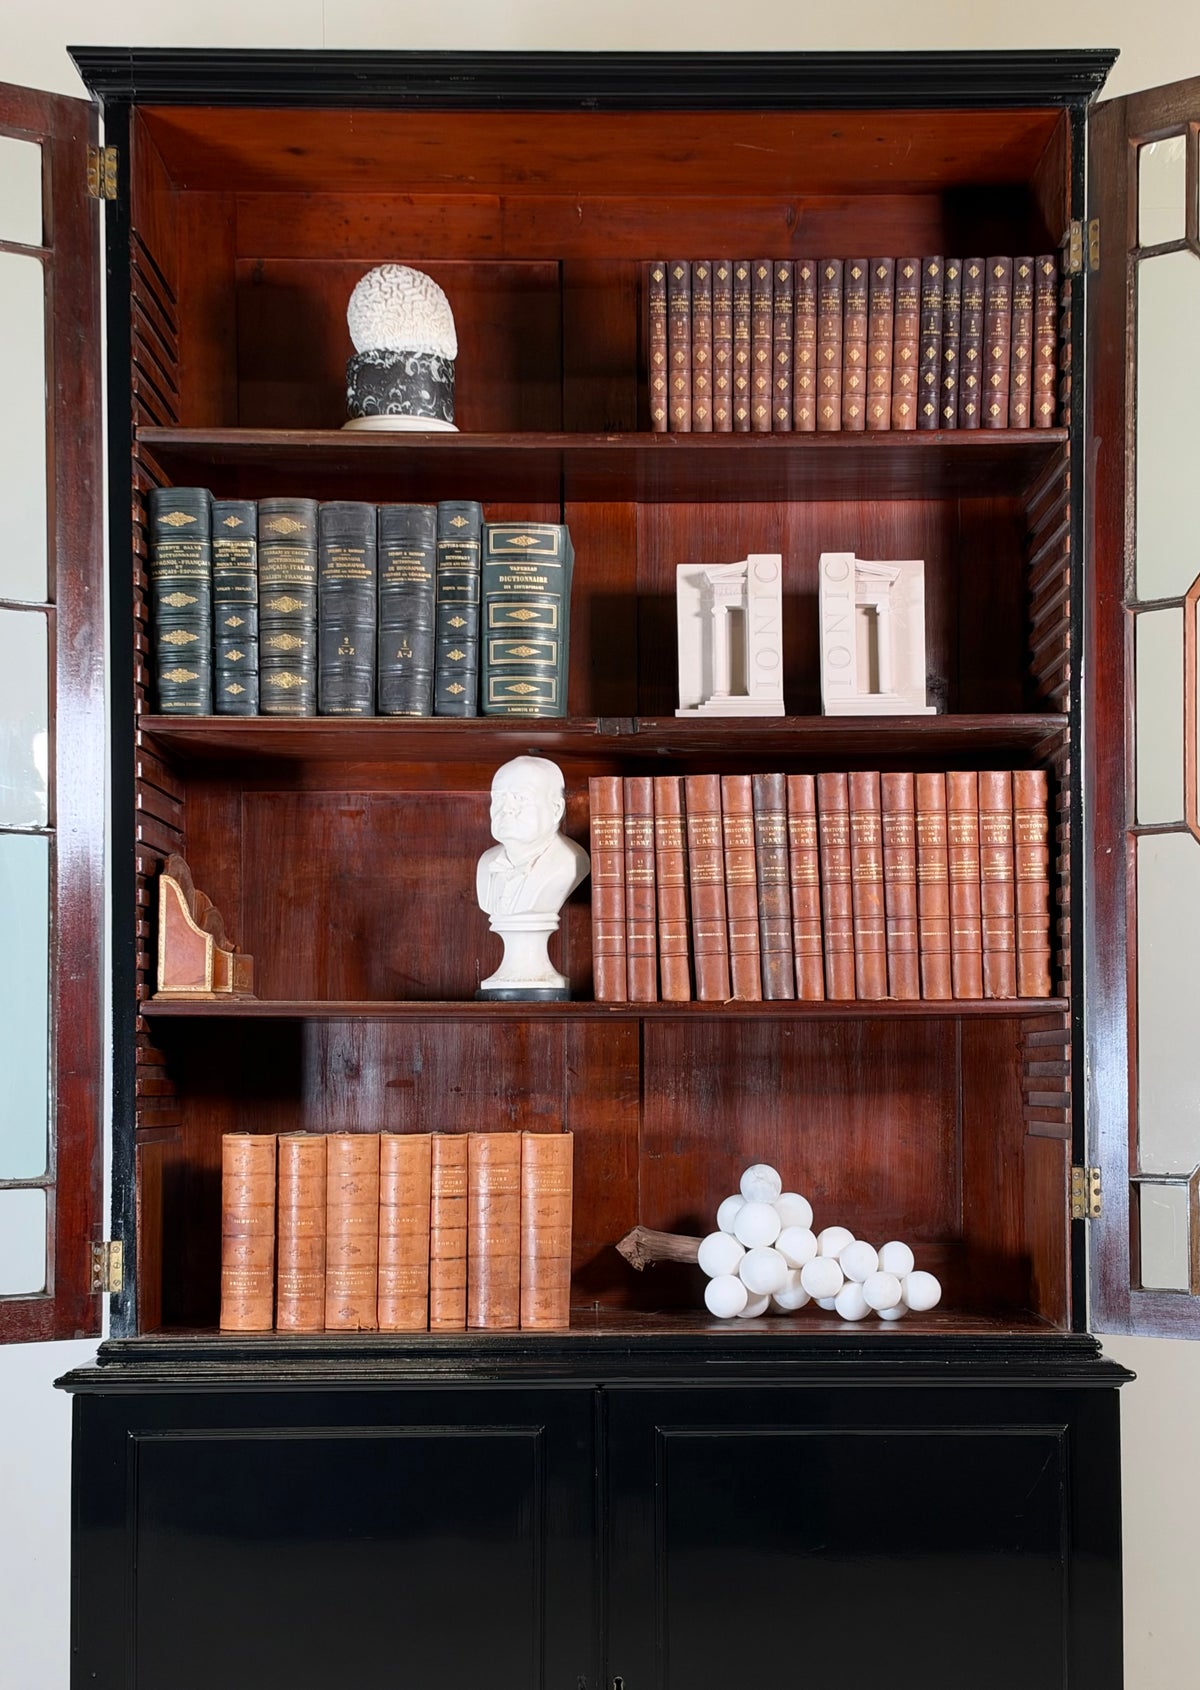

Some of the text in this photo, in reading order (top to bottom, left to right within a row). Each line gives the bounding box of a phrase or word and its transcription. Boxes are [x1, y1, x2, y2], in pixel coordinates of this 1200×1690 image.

[499, 575, 548, 584] DICTIONNAIRE
[753, 562, 780, 689] IONIC
[824, 560, 852, 687] IONIC
[338, 647, 355, 655] K-Z
[396, 650, 413, 658] A-J
